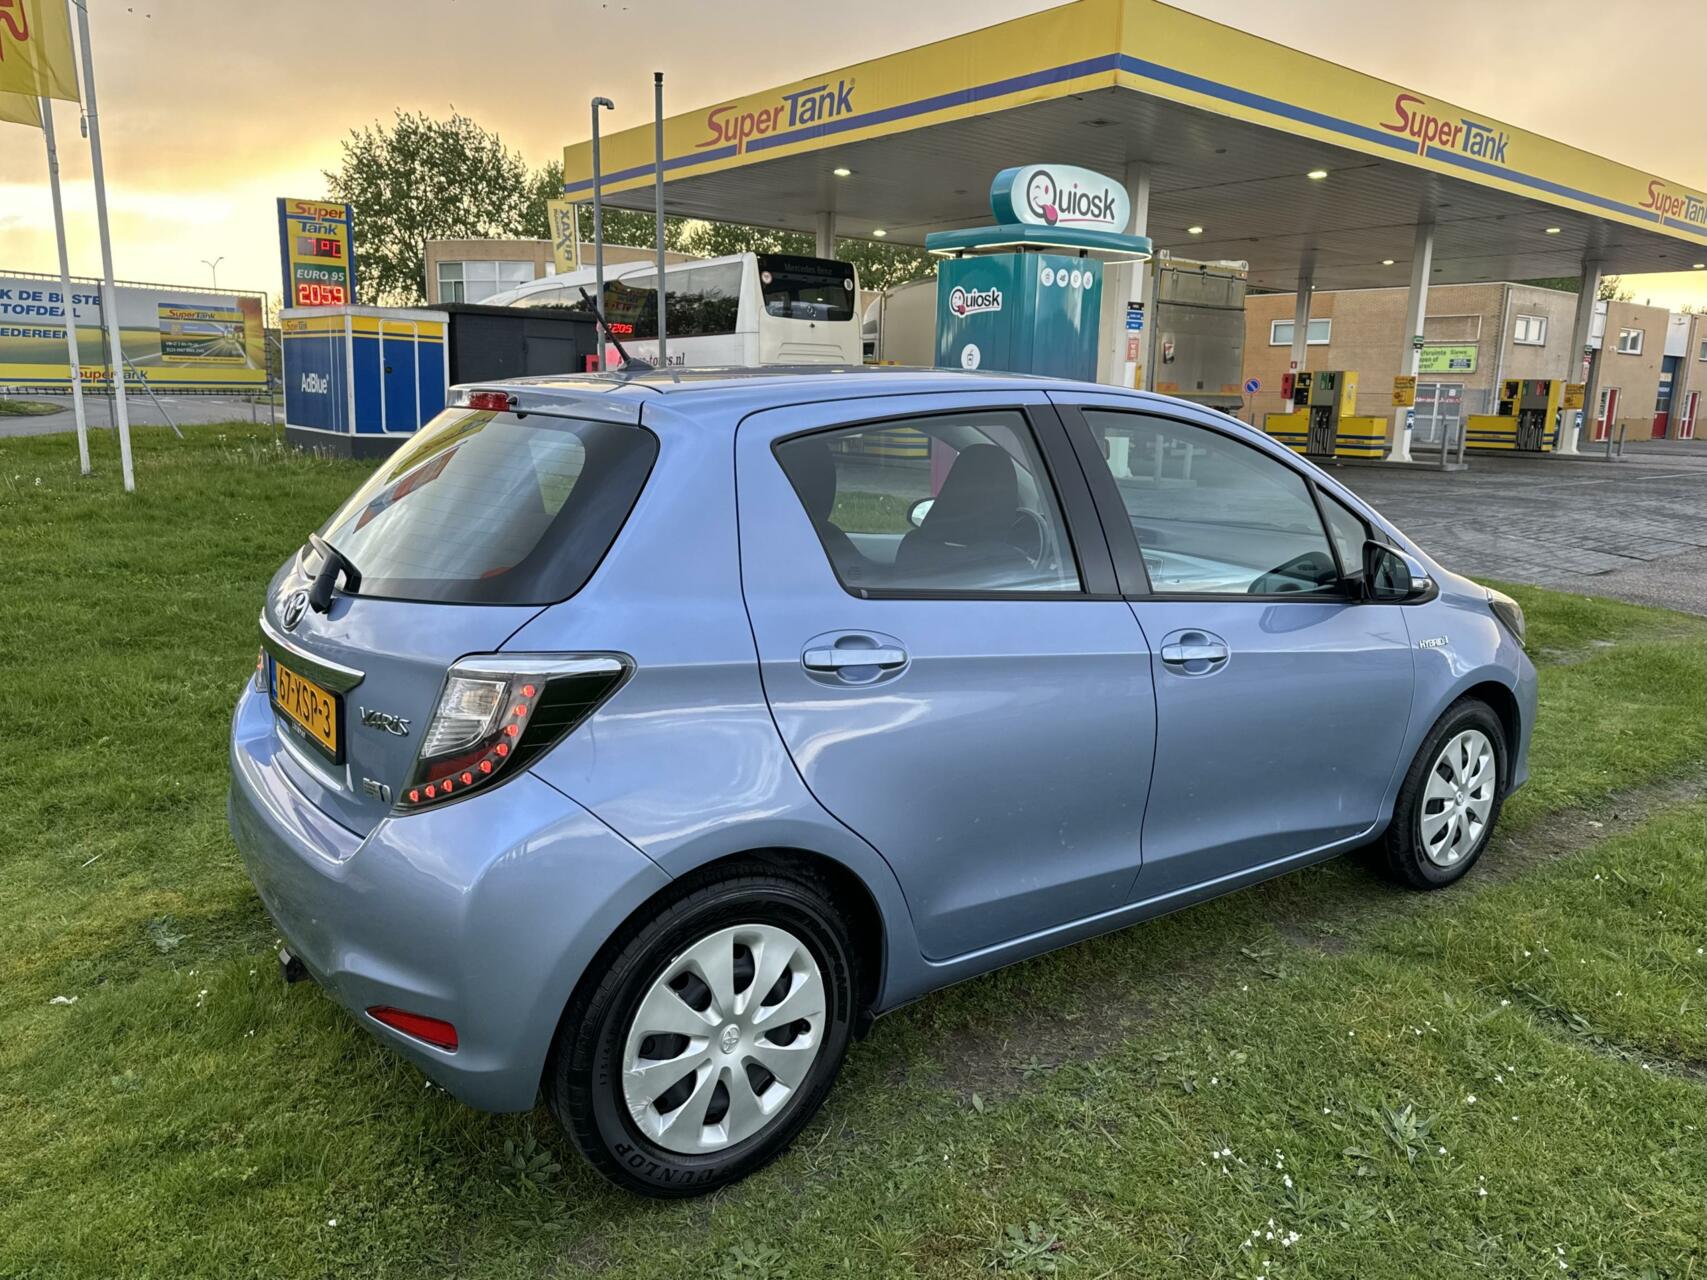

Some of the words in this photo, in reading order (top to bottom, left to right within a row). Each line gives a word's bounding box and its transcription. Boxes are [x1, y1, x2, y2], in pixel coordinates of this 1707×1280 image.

[1026, 169, 1116, 226] Quiosk
[1638, 180, 1707, 225] SuperTan
[287, 202, 345, 221] Super
[296, 220, 338, 235] Tank
[296, 269, 329, 280] EURO
[331, 271, 345, 281] 95
[18, 290, 43, 302] DE
[48, 292, 101, 306] BSTE
[950, 287, 1000, 315] Quiosk
[301, 372, 329, 394] AdBlue
[280, 667, 331, 738] 67-XSP-3
[614, 1143, 714, 1184] DUNLOP
